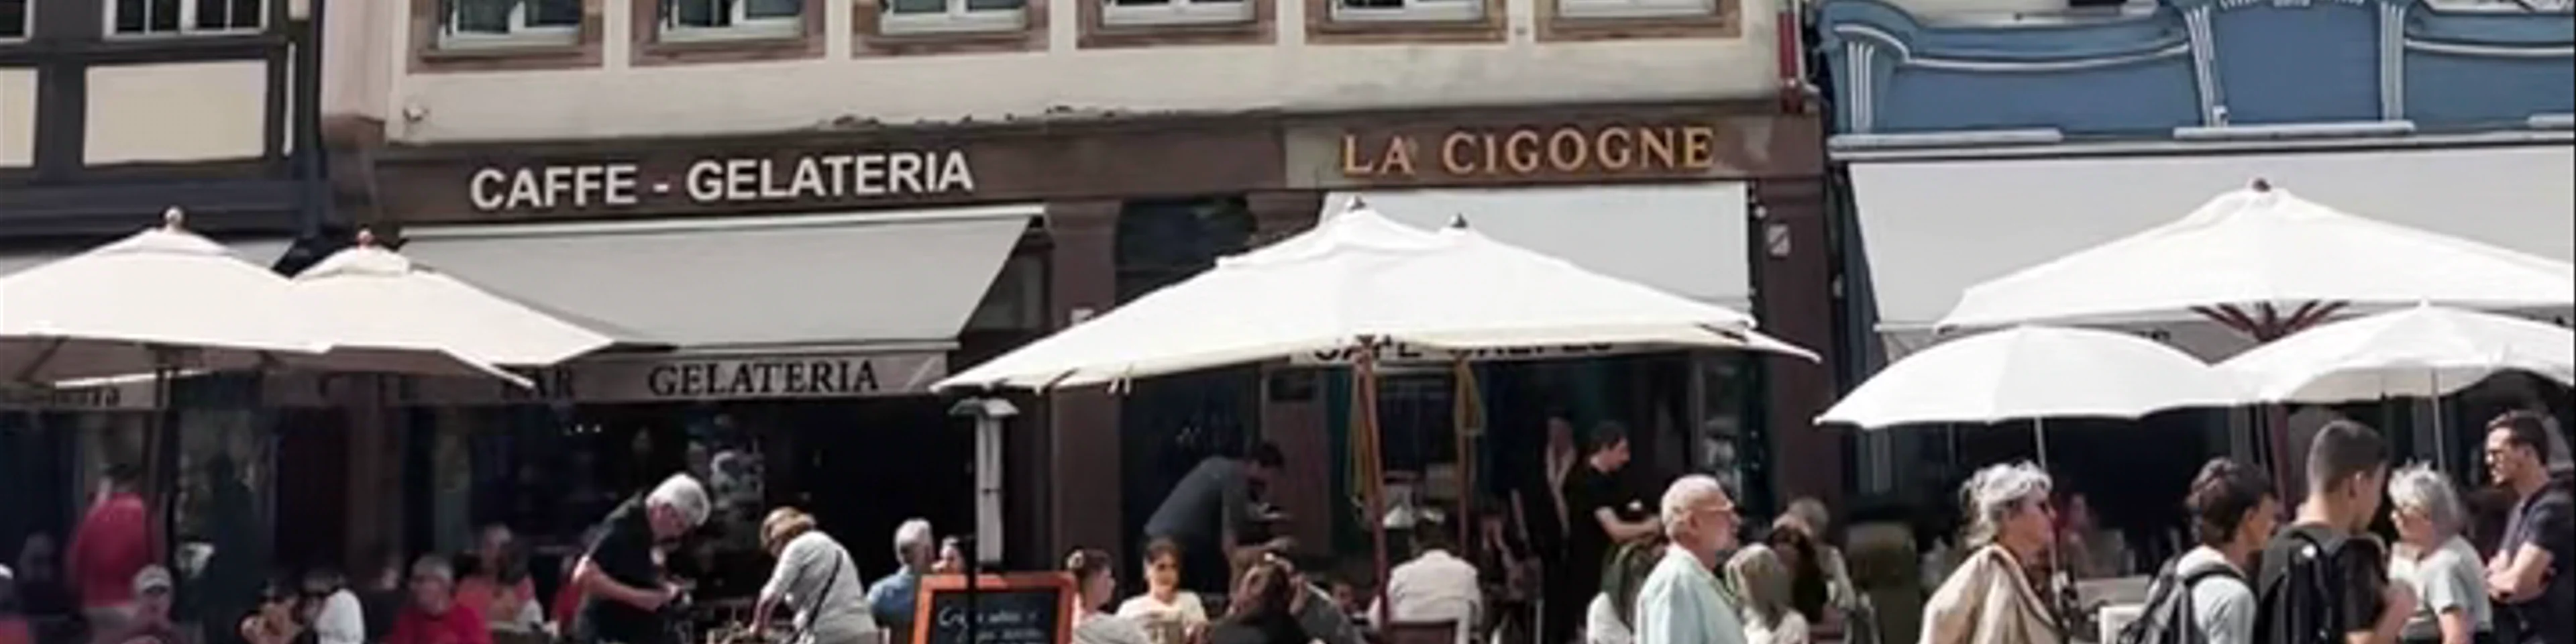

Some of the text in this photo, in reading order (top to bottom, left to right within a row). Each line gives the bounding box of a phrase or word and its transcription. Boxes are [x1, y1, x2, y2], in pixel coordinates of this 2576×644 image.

[1344, 126, 1715, 174] LA CIGOGNE
[470, 166, 638, 210] CAFFE
[686, 150, 974, 202] GELATERIA
[648, 359, 879, 396] GELATERIA
